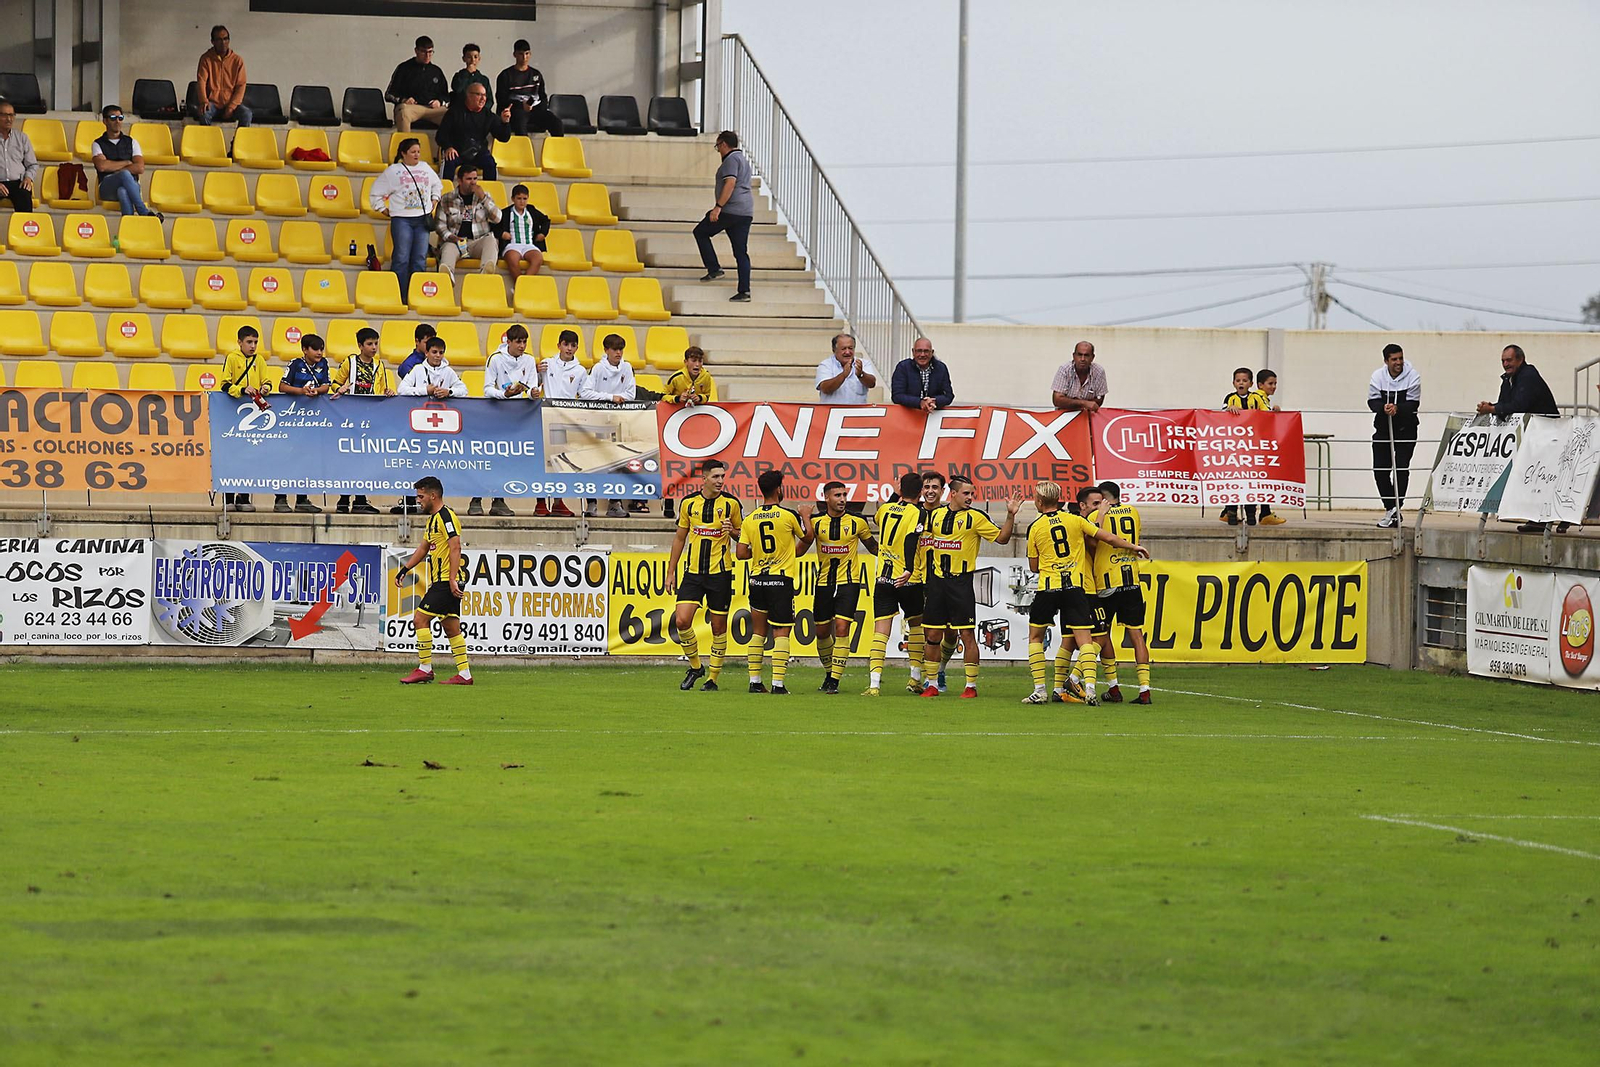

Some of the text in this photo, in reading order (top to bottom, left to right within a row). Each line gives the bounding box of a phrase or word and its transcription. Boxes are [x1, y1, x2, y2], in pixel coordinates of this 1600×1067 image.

[279, 401, 321, 418] Años
[552, 400, 588, 409] RESONANCIA
[622, 403, 647, 411] ABIERTA
[278, 418, 371, 430] cuidando de ti
[1166, 424, 1255, 440] SERVICIOS
[221, 426, 289, 441] Aniversario
[662, 404, 1082, 462] ONE FIX
[33, 439, 134, 456] COLCHONES
[150, 439, 205, 457] SOFÁS
[338, 433, 535, 459] CLÍNICAS SAN ROQUE
[1167, 438, 1279, 452] INTEGRALES
[1447, 432, 1516, 459] YESPLAC
[384, 458, 492, 472] LEPE AYAMONTE
[1202, 452, 1281, 468] SUÁREZ
[0, 459, 148, 490] 38 63
[665, 460, 879, 481] REARACION
[948, 462, 1090, 484] MOVILES
[1137, 470, 1269, 482] SIEMPRE AVANZANDO
[531, 482, 656, 497] 959 38 20 20
[1146, 481, 1199, 493] Pintura
[1206, 482, 1305, 495] Dpto. Limpieza
[1136, 492, 1167, 504] 222
[1171, 492, 1200, 505] 023
[1209, 492, 1305, 510] 693 652 255
[758, 520, 776, 554] 6
[880, 512, 903, 546] 17
[1109, 516, 1136, 549] 19
[55, 539, 145, 554] CANINA
[827, 545, 849, 555] jamón
[939, 541, 961, 550] jamón
[1050, 525, 1071, 559] 8
[0, 560, 125, 582] OCOS POR
[154, 557, 266, 602] ELECTROFRIO
[271, 560, 293, 603] DE
[12, 586, 146, 610] LOS RIZOS
[460, 592, 605, 619] BRAS Y REFORMAS
[24, 612, 133, 626] 624 23 44 66
[1189, 573, 1361, 653] PICOTE
[387, 619, 416, 638] 679
[502, 622, 534, 641] 679
[538, 624, 569, 642] 491
[574, 624, 605, 643] 840
[1489, 660, 1501, 674] 959
